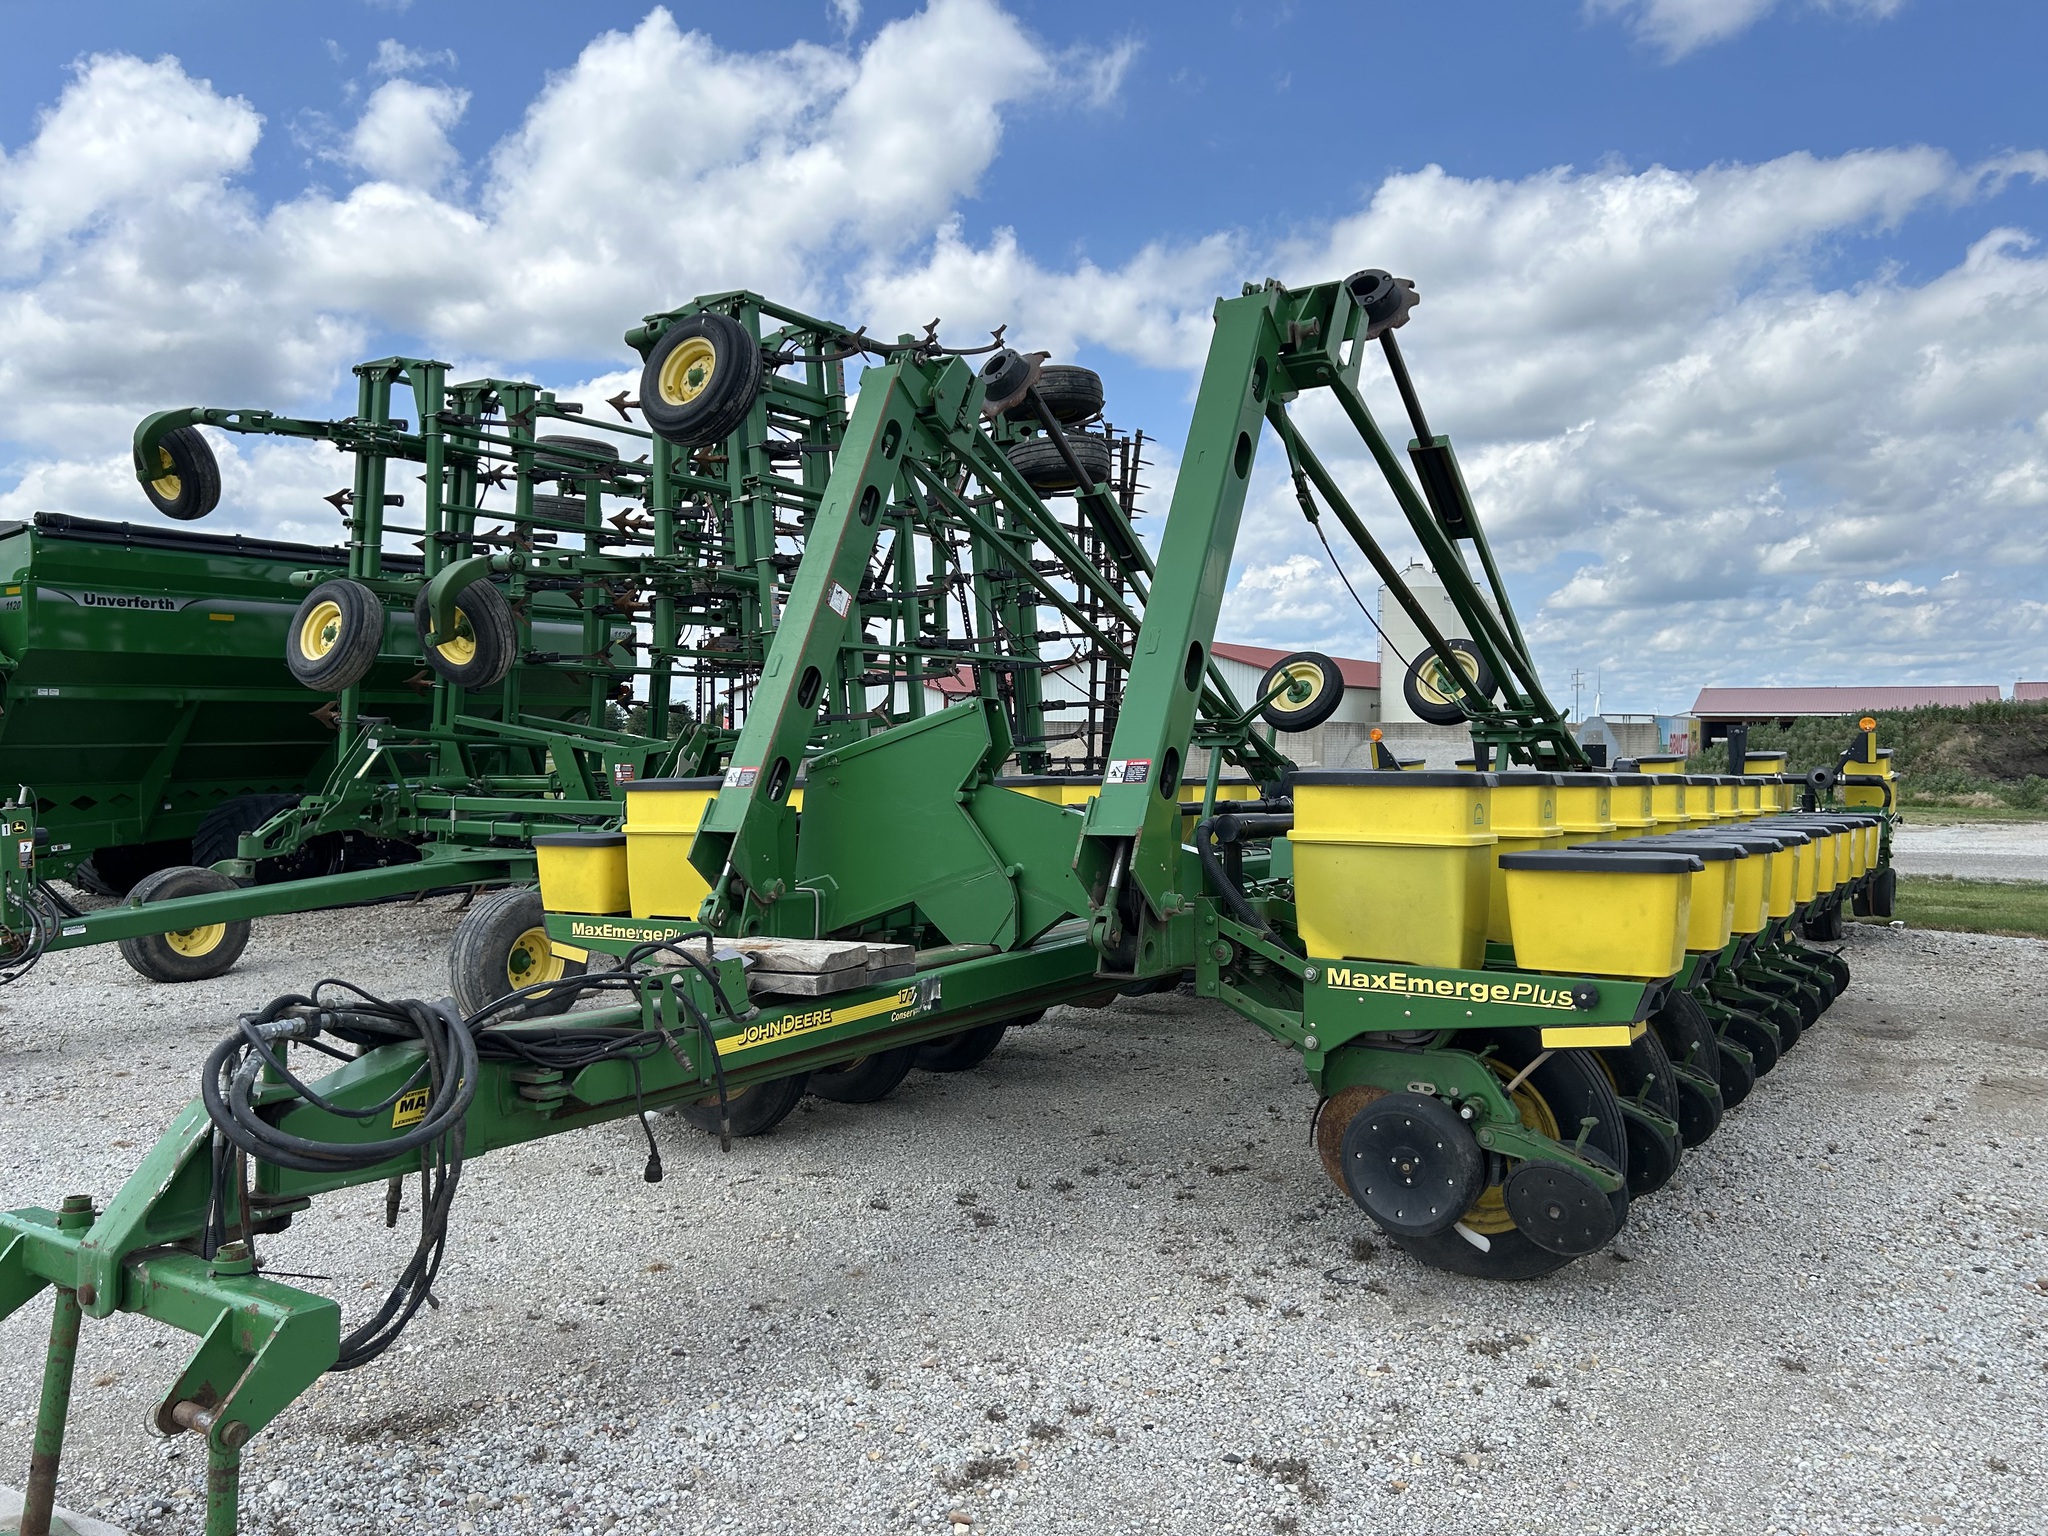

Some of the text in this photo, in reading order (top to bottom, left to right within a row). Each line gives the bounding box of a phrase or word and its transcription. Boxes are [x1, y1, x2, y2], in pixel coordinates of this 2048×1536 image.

[6, 600, 21, 610] 1120
[83, 593, 175, 610] Unverferth
[572, 922, 687, 942] MaxEmergePl
